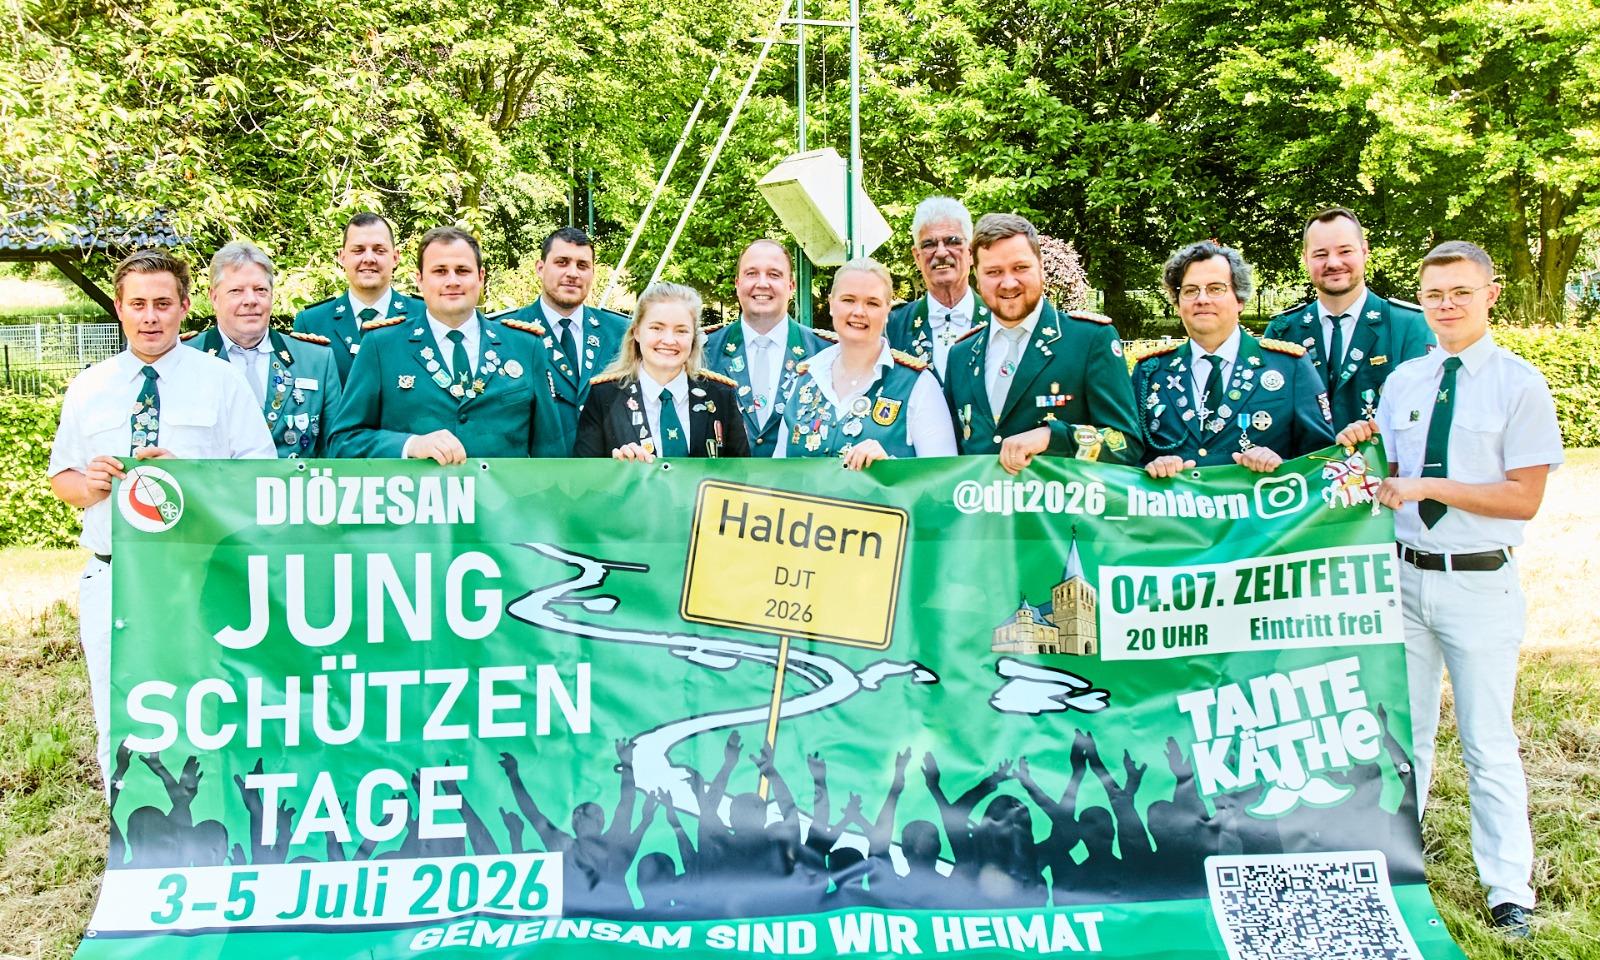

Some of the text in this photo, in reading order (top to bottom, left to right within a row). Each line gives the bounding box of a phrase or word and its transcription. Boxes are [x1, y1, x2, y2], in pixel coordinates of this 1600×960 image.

[256, 468, 476, 525] DIÖZESAN
[953, 479, 1250, 520] @djt2026_haldern
[718, 499, 882, 559] Haldern
[213, 551, 503, 649] JUNG
[774, 567, 815, 589] DJT
[1111, 553, 1394, 614] 04.07. ZELTFETE
[764, 599, 813, 623] 2026
[1126, 610, 1382, 651] 20 UHR Eintritt frei
[124, 655, 592, 753] SCHÜTZEN
[245, 765, 468, 846] TAGE
[276, 866, 388, 920] Juli
[409, 859, 549, 916] 2026
[409, 911, 1104, 956] GEMEINSAM SIND WIR HEIMAT
